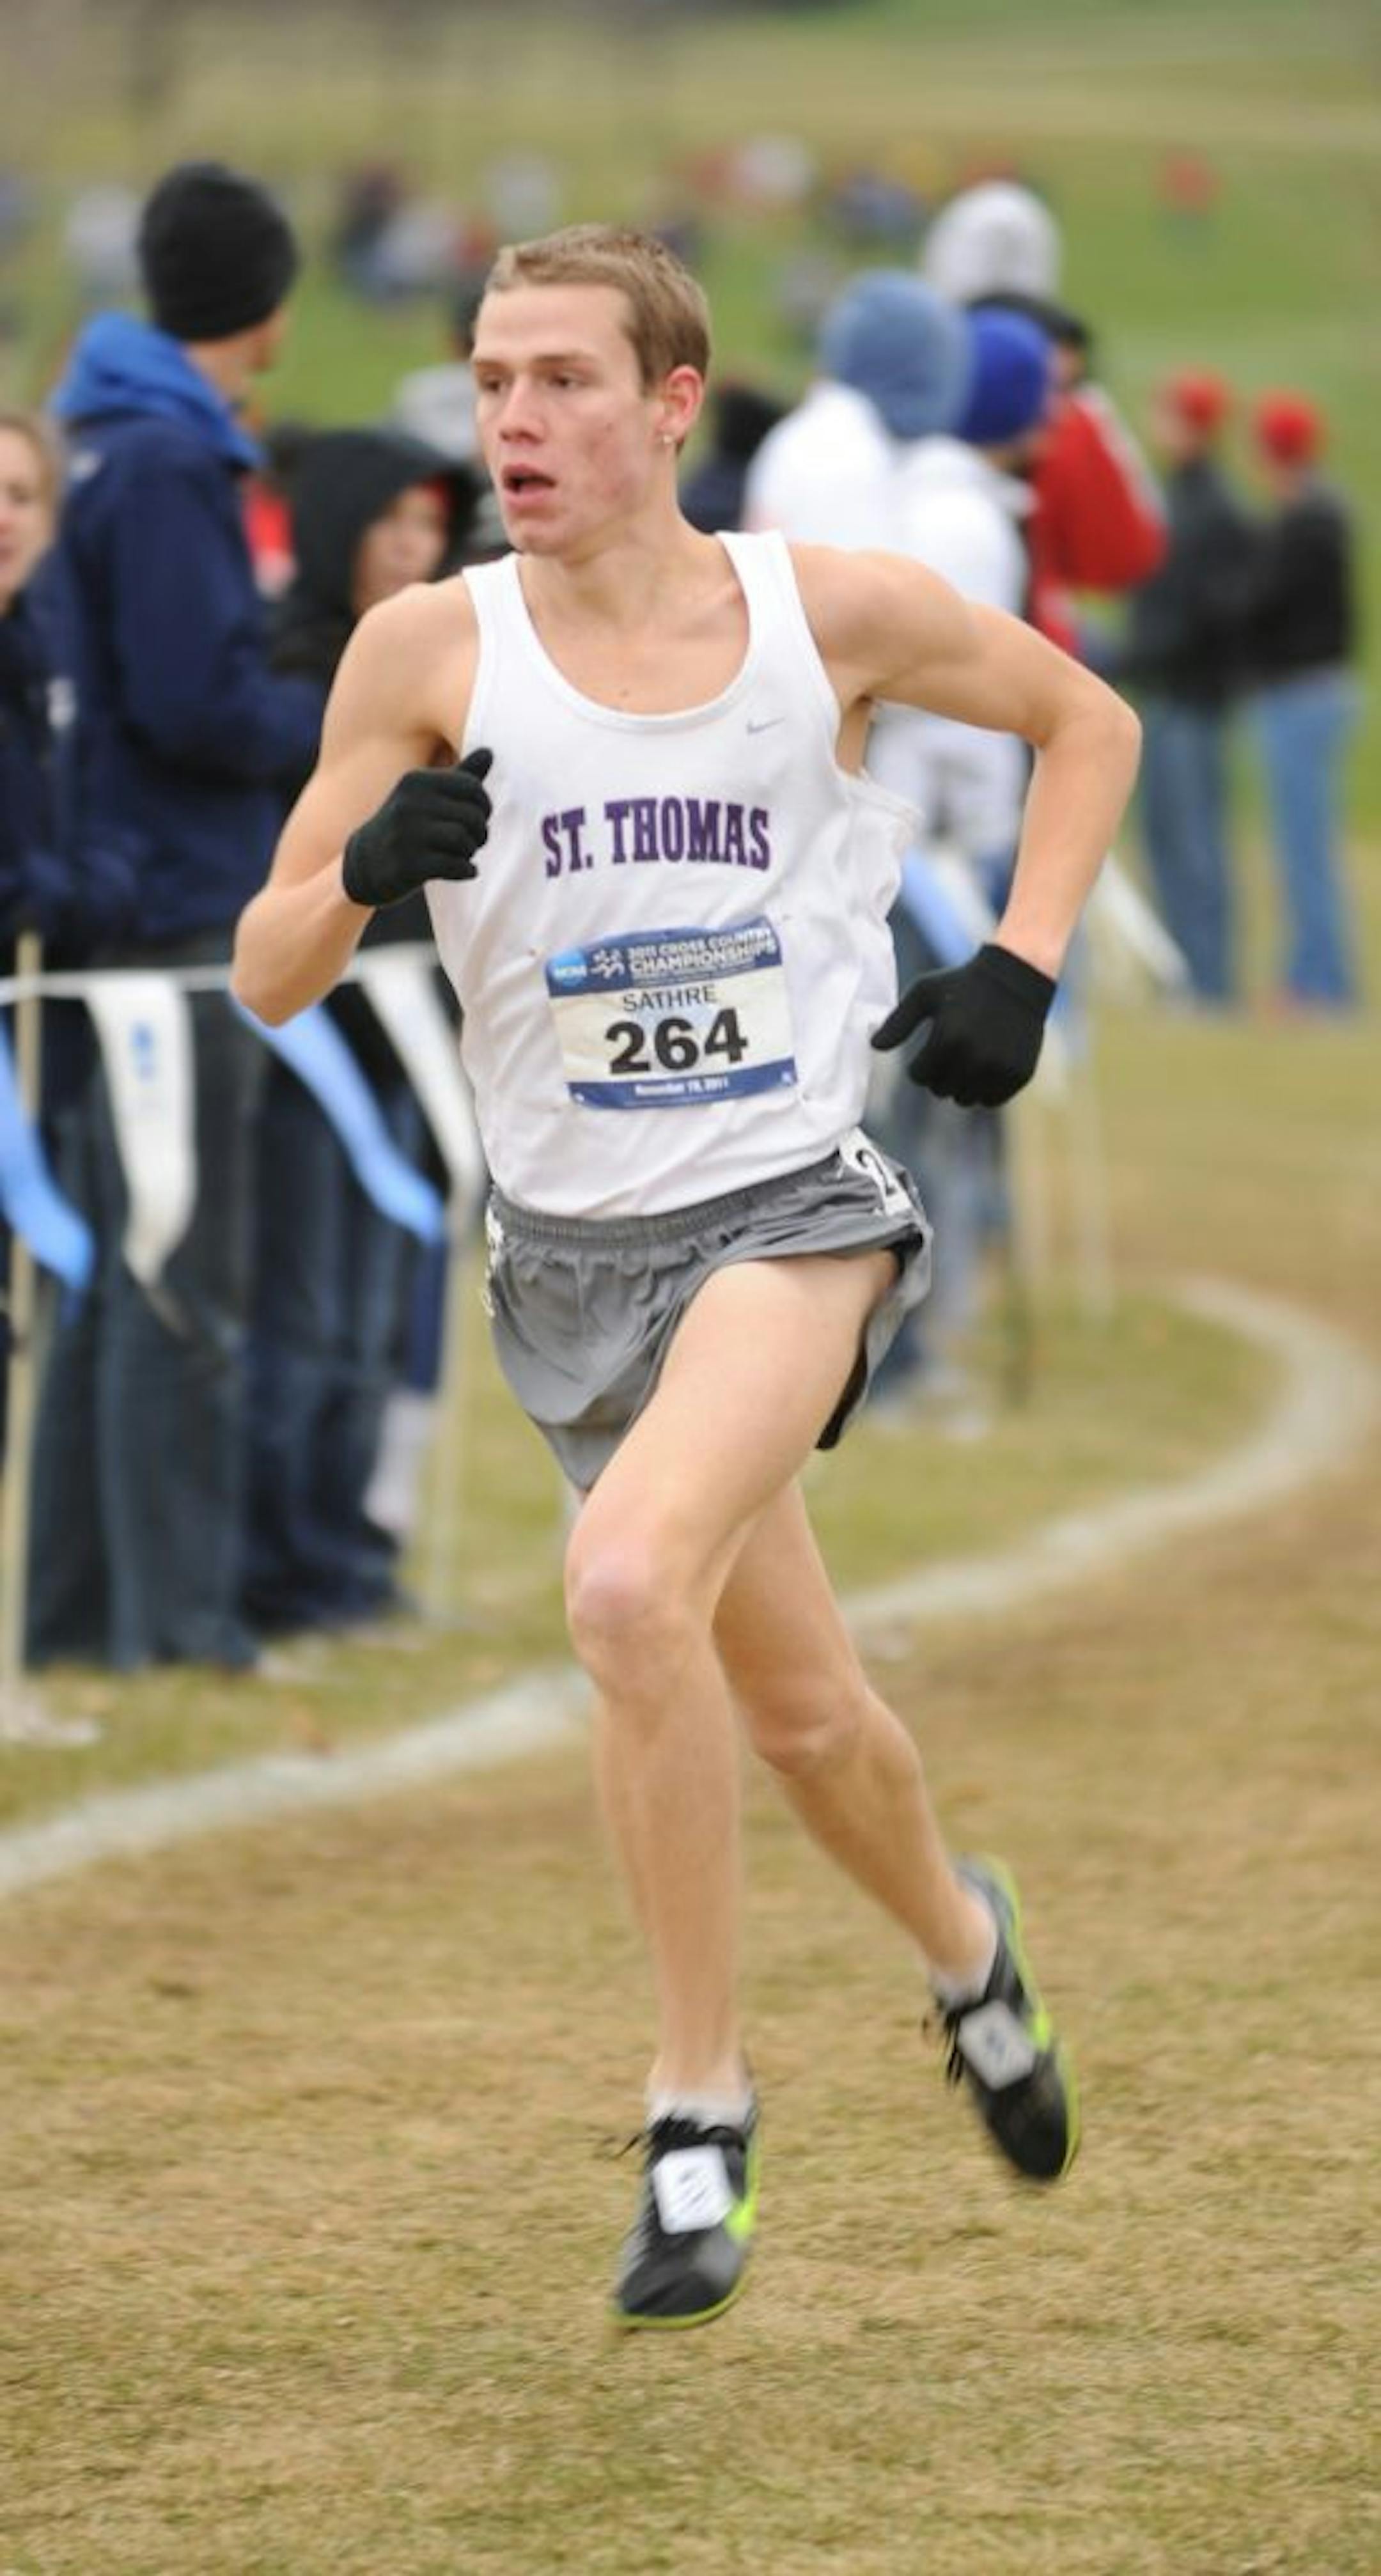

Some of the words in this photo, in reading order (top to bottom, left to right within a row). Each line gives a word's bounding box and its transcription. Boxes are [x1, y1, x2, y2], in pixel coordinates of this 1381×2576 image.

[542, 806, 593, 878] ST.
[605, 797, 770, 871] THOMAS
[623, 985, 718, 1013] SATHRE
[605, 1007, 748, 1075] 264
